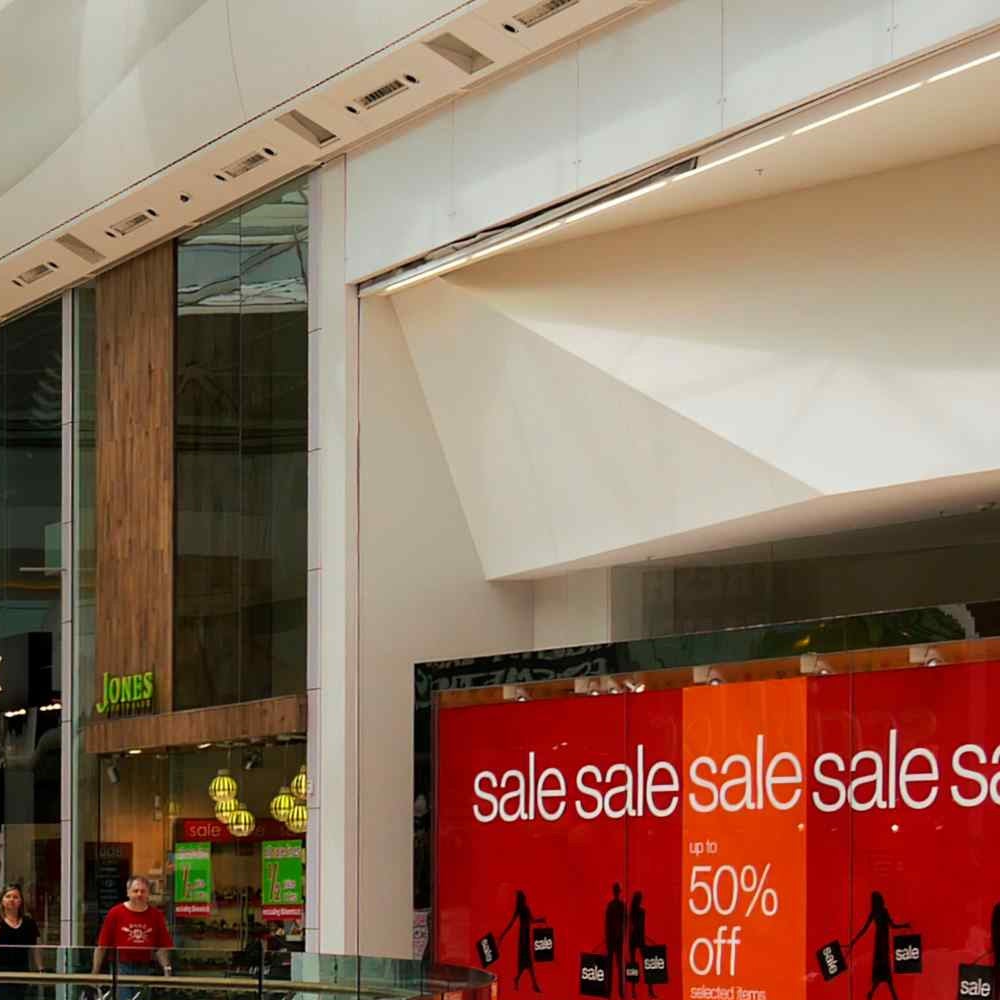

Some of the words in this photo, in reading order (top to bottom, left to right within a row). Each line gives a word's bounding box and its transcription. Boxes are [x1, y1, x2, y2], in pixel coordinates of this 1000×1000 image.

[96, 671, 153, 713] JONES
[473, 752, 566, 823] sale
[575, 744, 680, 819] sale
[689, 734, 802, 812] sale
[812, 729, 939, 813] sale
[189, 822, 222, 838] sale
[689, 842, 704, 856] up
[705, 840, 718, 854] to
[688, 863, 779, 917] 50%
[534, 937, 553, 951] sale
[689, 925, 742, 976] off
[822, 946, 839, 975] sale
[895, 945, 920, 961] sale
[644, 956, 665, 970] sale
[582, 965, 605, 981] sale
[690, 984, 735, 1000] selected
[960, 978, 991, 997] sale
